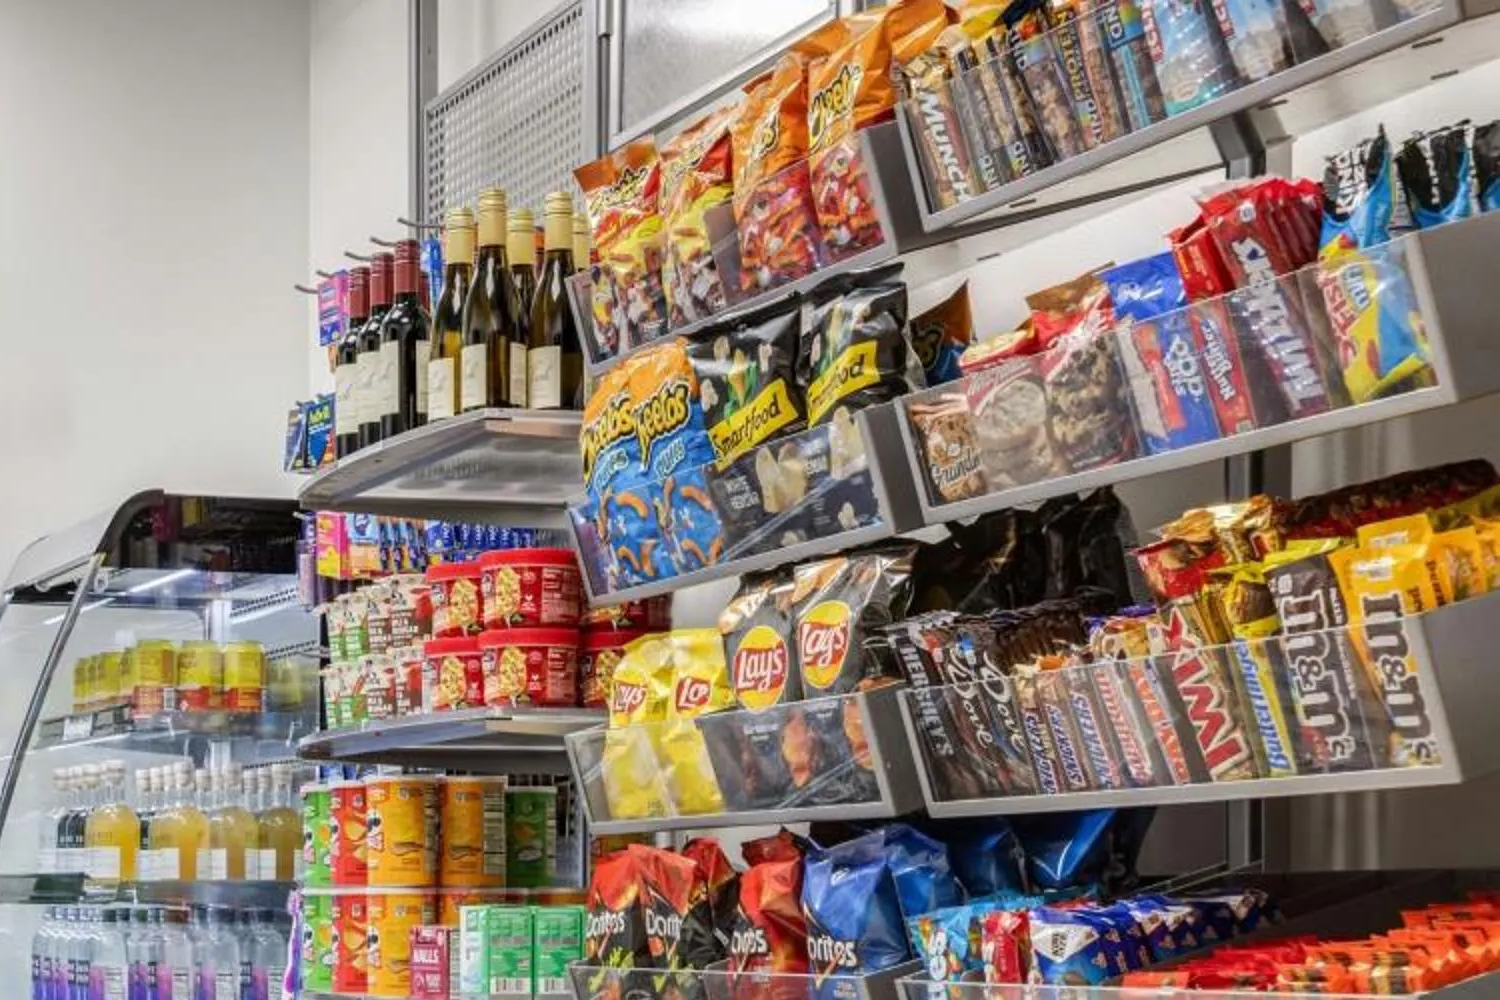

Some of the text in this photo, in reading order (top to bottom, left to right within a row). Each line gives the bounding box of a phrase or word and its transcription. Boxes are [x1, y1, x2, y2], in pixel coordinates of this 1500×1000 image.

[1100, 0, 1125, 41] ND
[802, 616, 848, 666] Lay's
[736, 643, 785, 694] Lay's
[891, 635, 953, 755] HERSHEY'S
[1235, 638, 1289, 770] Butterfinge
[807, 933, 857, 968] oritos
